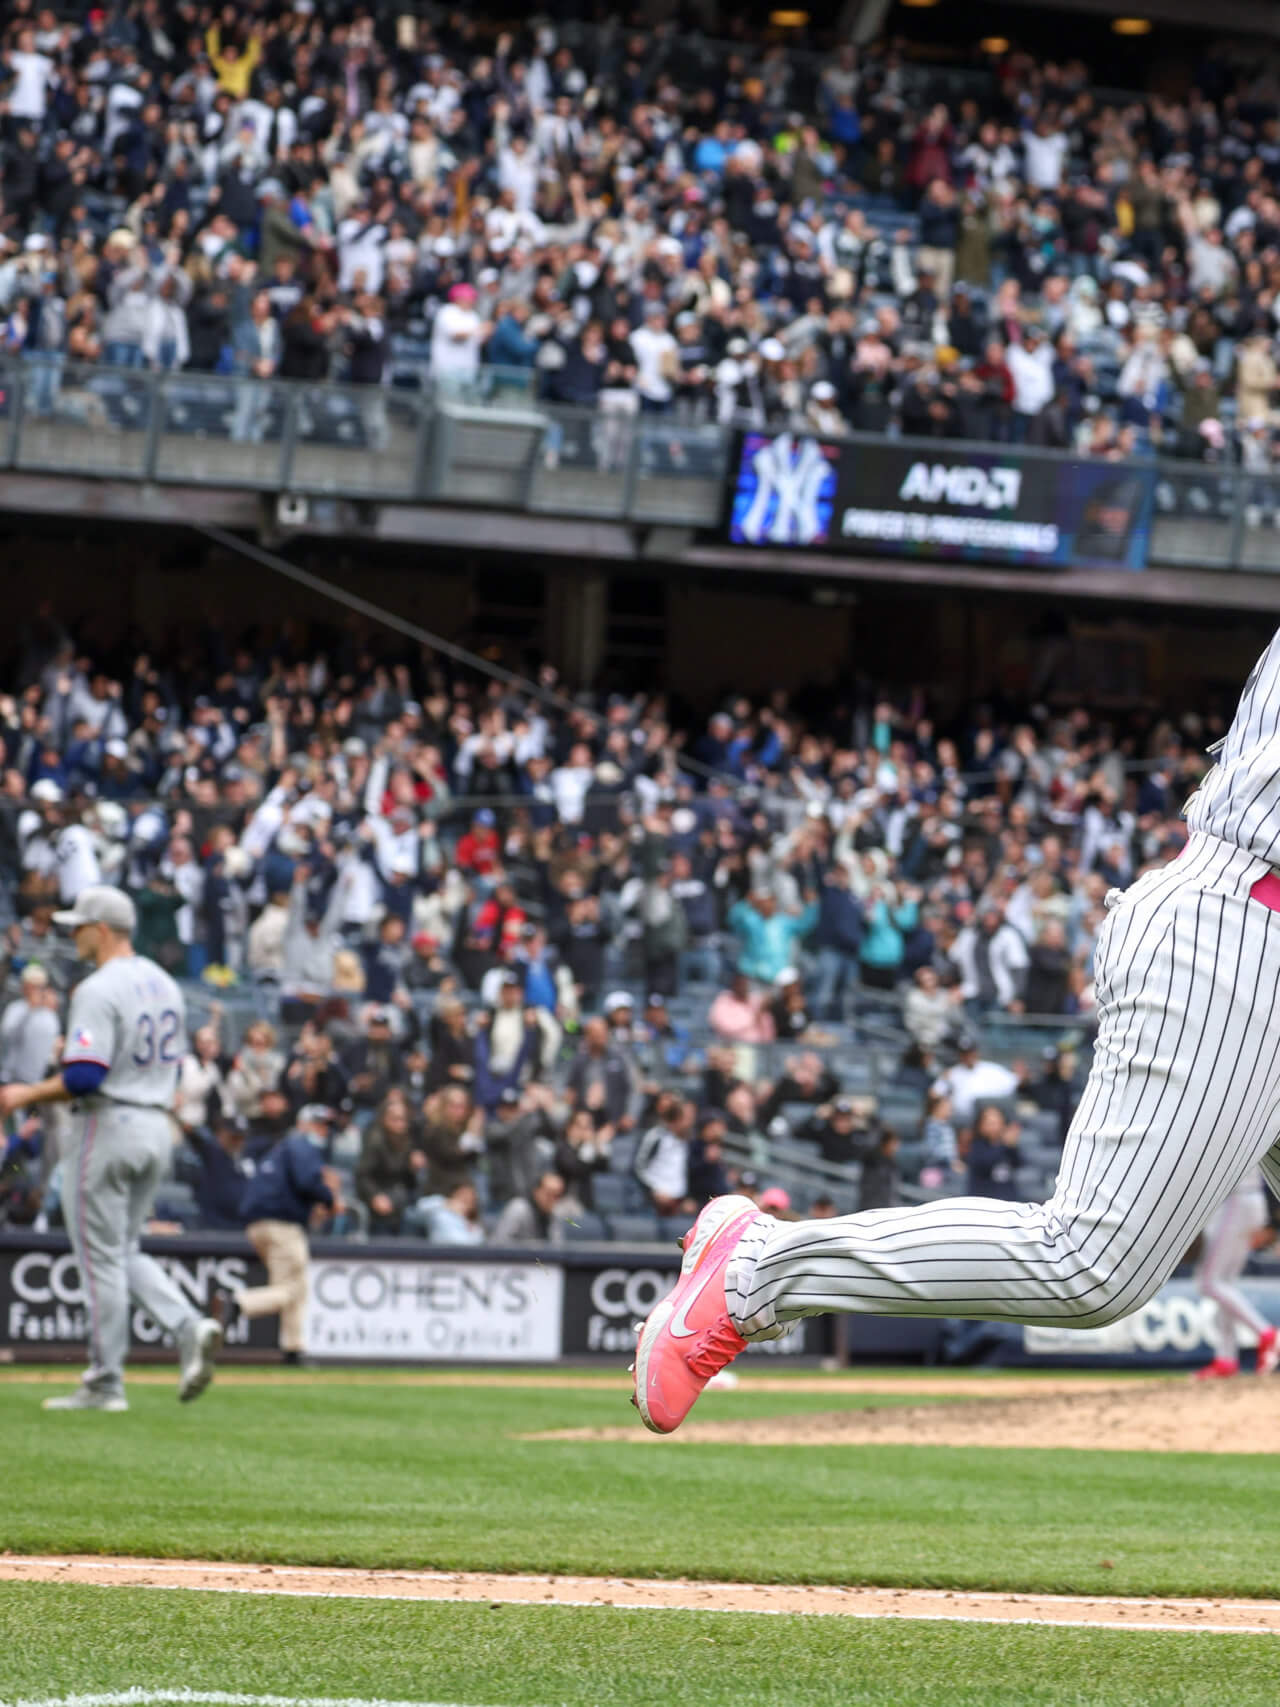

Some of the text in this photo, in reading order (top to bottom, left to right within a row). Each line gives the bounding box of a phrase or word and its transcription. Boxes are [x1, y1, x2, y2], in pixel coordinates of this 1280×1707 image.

[740, 432, 833, 543] NY
[899, 462, 989, 506] AMD
[132, 1008, 180, 1066] 32
[314, 1265, 530, 1314] COHEN'S
